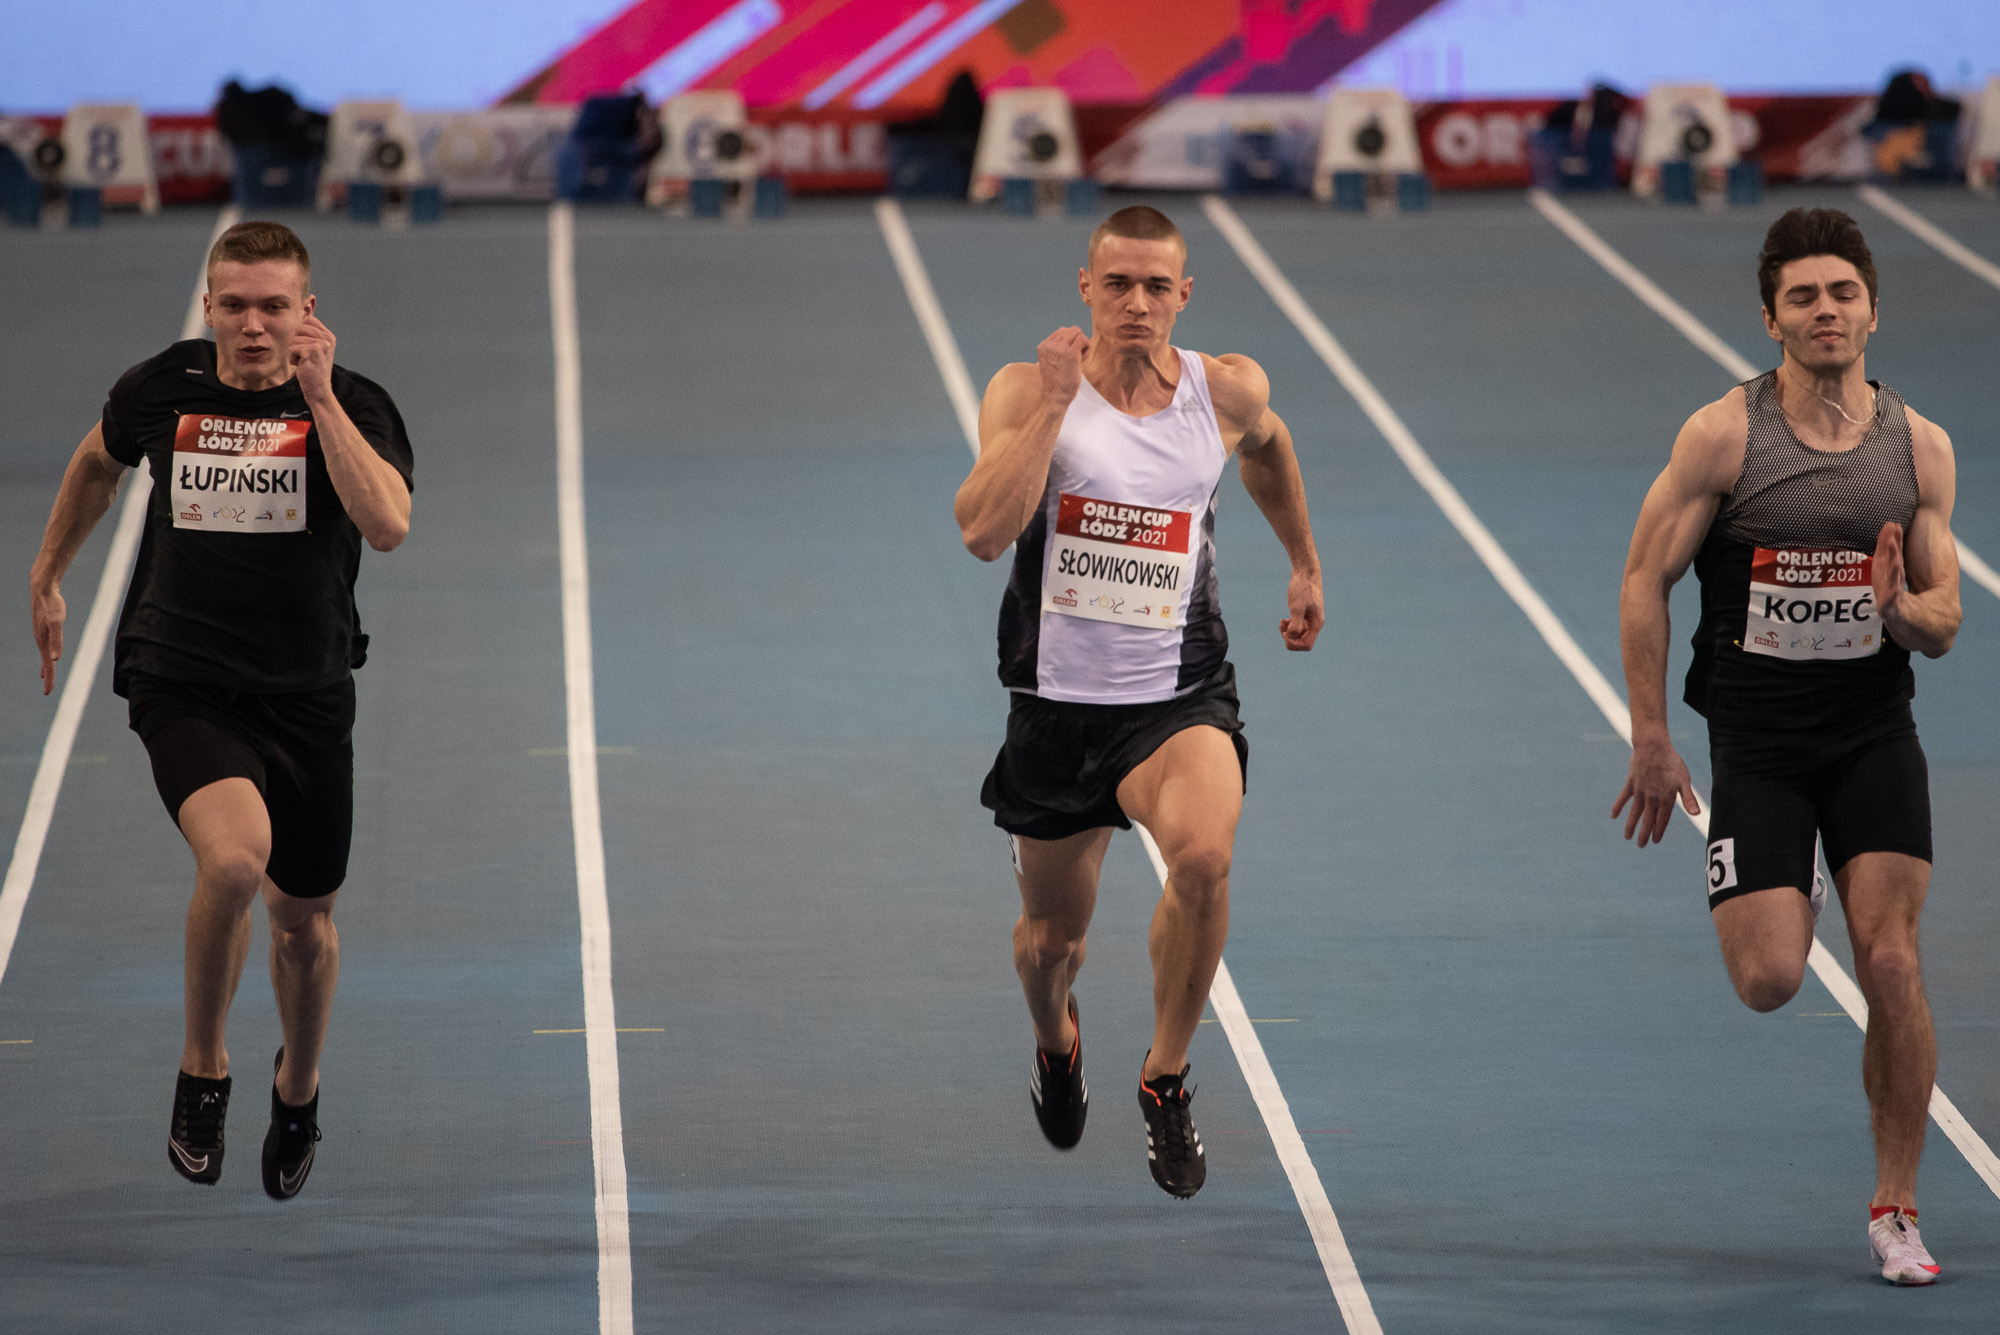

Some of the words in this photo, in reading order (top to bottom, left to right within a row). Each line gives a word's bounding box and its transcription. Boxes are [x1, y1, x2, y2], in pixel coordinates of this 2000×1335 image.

[86, 124, 121, 176] 8
[200, 418, 256, 435] ORLEN
[258, 421, 287, 435] CUP
[198, 433, 244, 451] ŁÓDŹ
[248, 439, 279, 452] 2021
[180, 463, 297, 494] ŁUPIŃSKI
[1083, 502, 1140, 524] ORLEN
[1142, 513, 1172, 527] CUP
[1079, 519, 1128, 540] ŁÓDŹ
[1132, 528, 1167, 545] 2021
[1058, 548, 1179, 590] SŁOWIKOWSKI
[1776, 551, 1833, 566] ORLEN
[1835, 551, 1868, 564] CUP
[1776, 566, 1822, 583] ŁÓDŹ
[1827, 568, 1863, 582] 2021
[1765, 593, 1873, 624] KOPEĆ
[1709, 845, 1726, 888] 5
